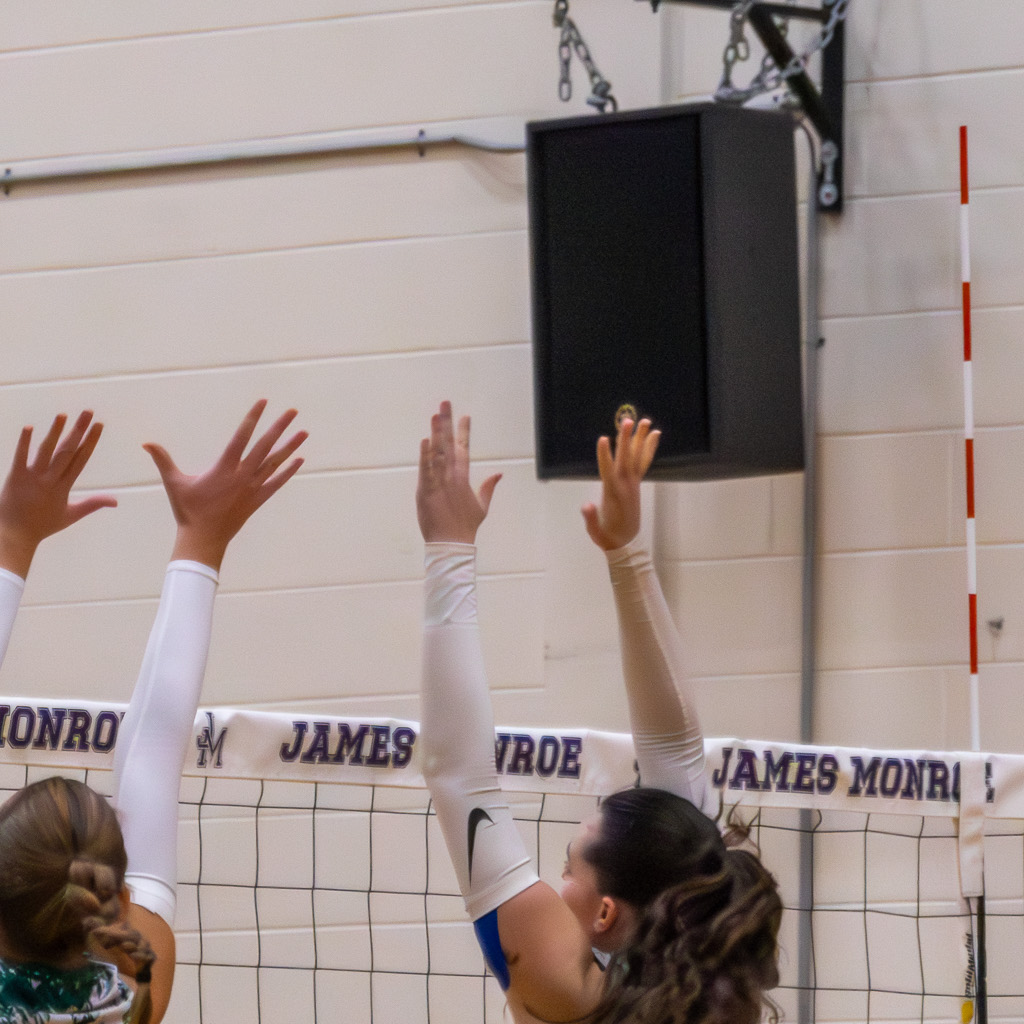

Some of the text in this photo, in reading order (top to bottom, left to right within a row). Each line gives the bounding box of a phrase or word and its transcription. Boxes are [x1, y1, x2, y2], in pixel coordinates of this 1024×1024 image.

[280, 721, 416, 768] JAMES
[713, 748, 995, 804] JAMES MONR
